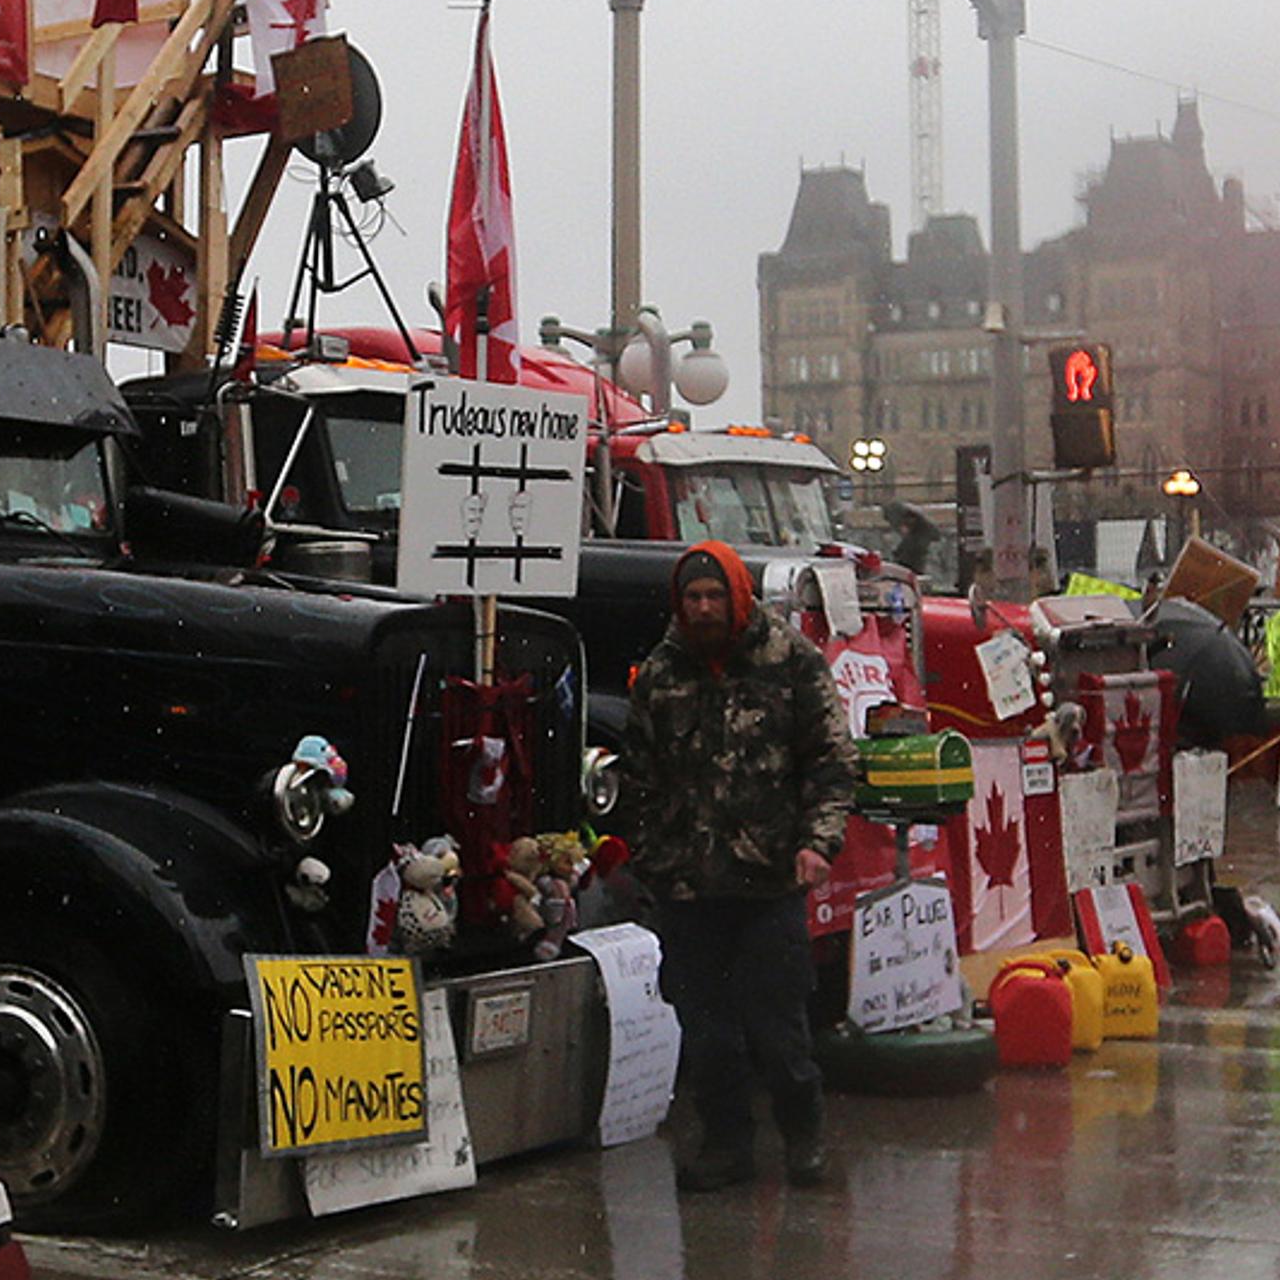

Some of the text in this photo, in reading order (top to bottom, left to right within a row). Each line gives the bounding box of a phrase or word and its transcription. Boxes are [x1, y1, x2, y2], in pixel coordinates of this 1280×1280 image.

[411, 381, 506, 438] Trudeaus
[263, 963, 407, 1052] NO VACCINE
[320, 1004, 418, 1043] PASSPORTS
[269, 1064, 319, 1149] NO
